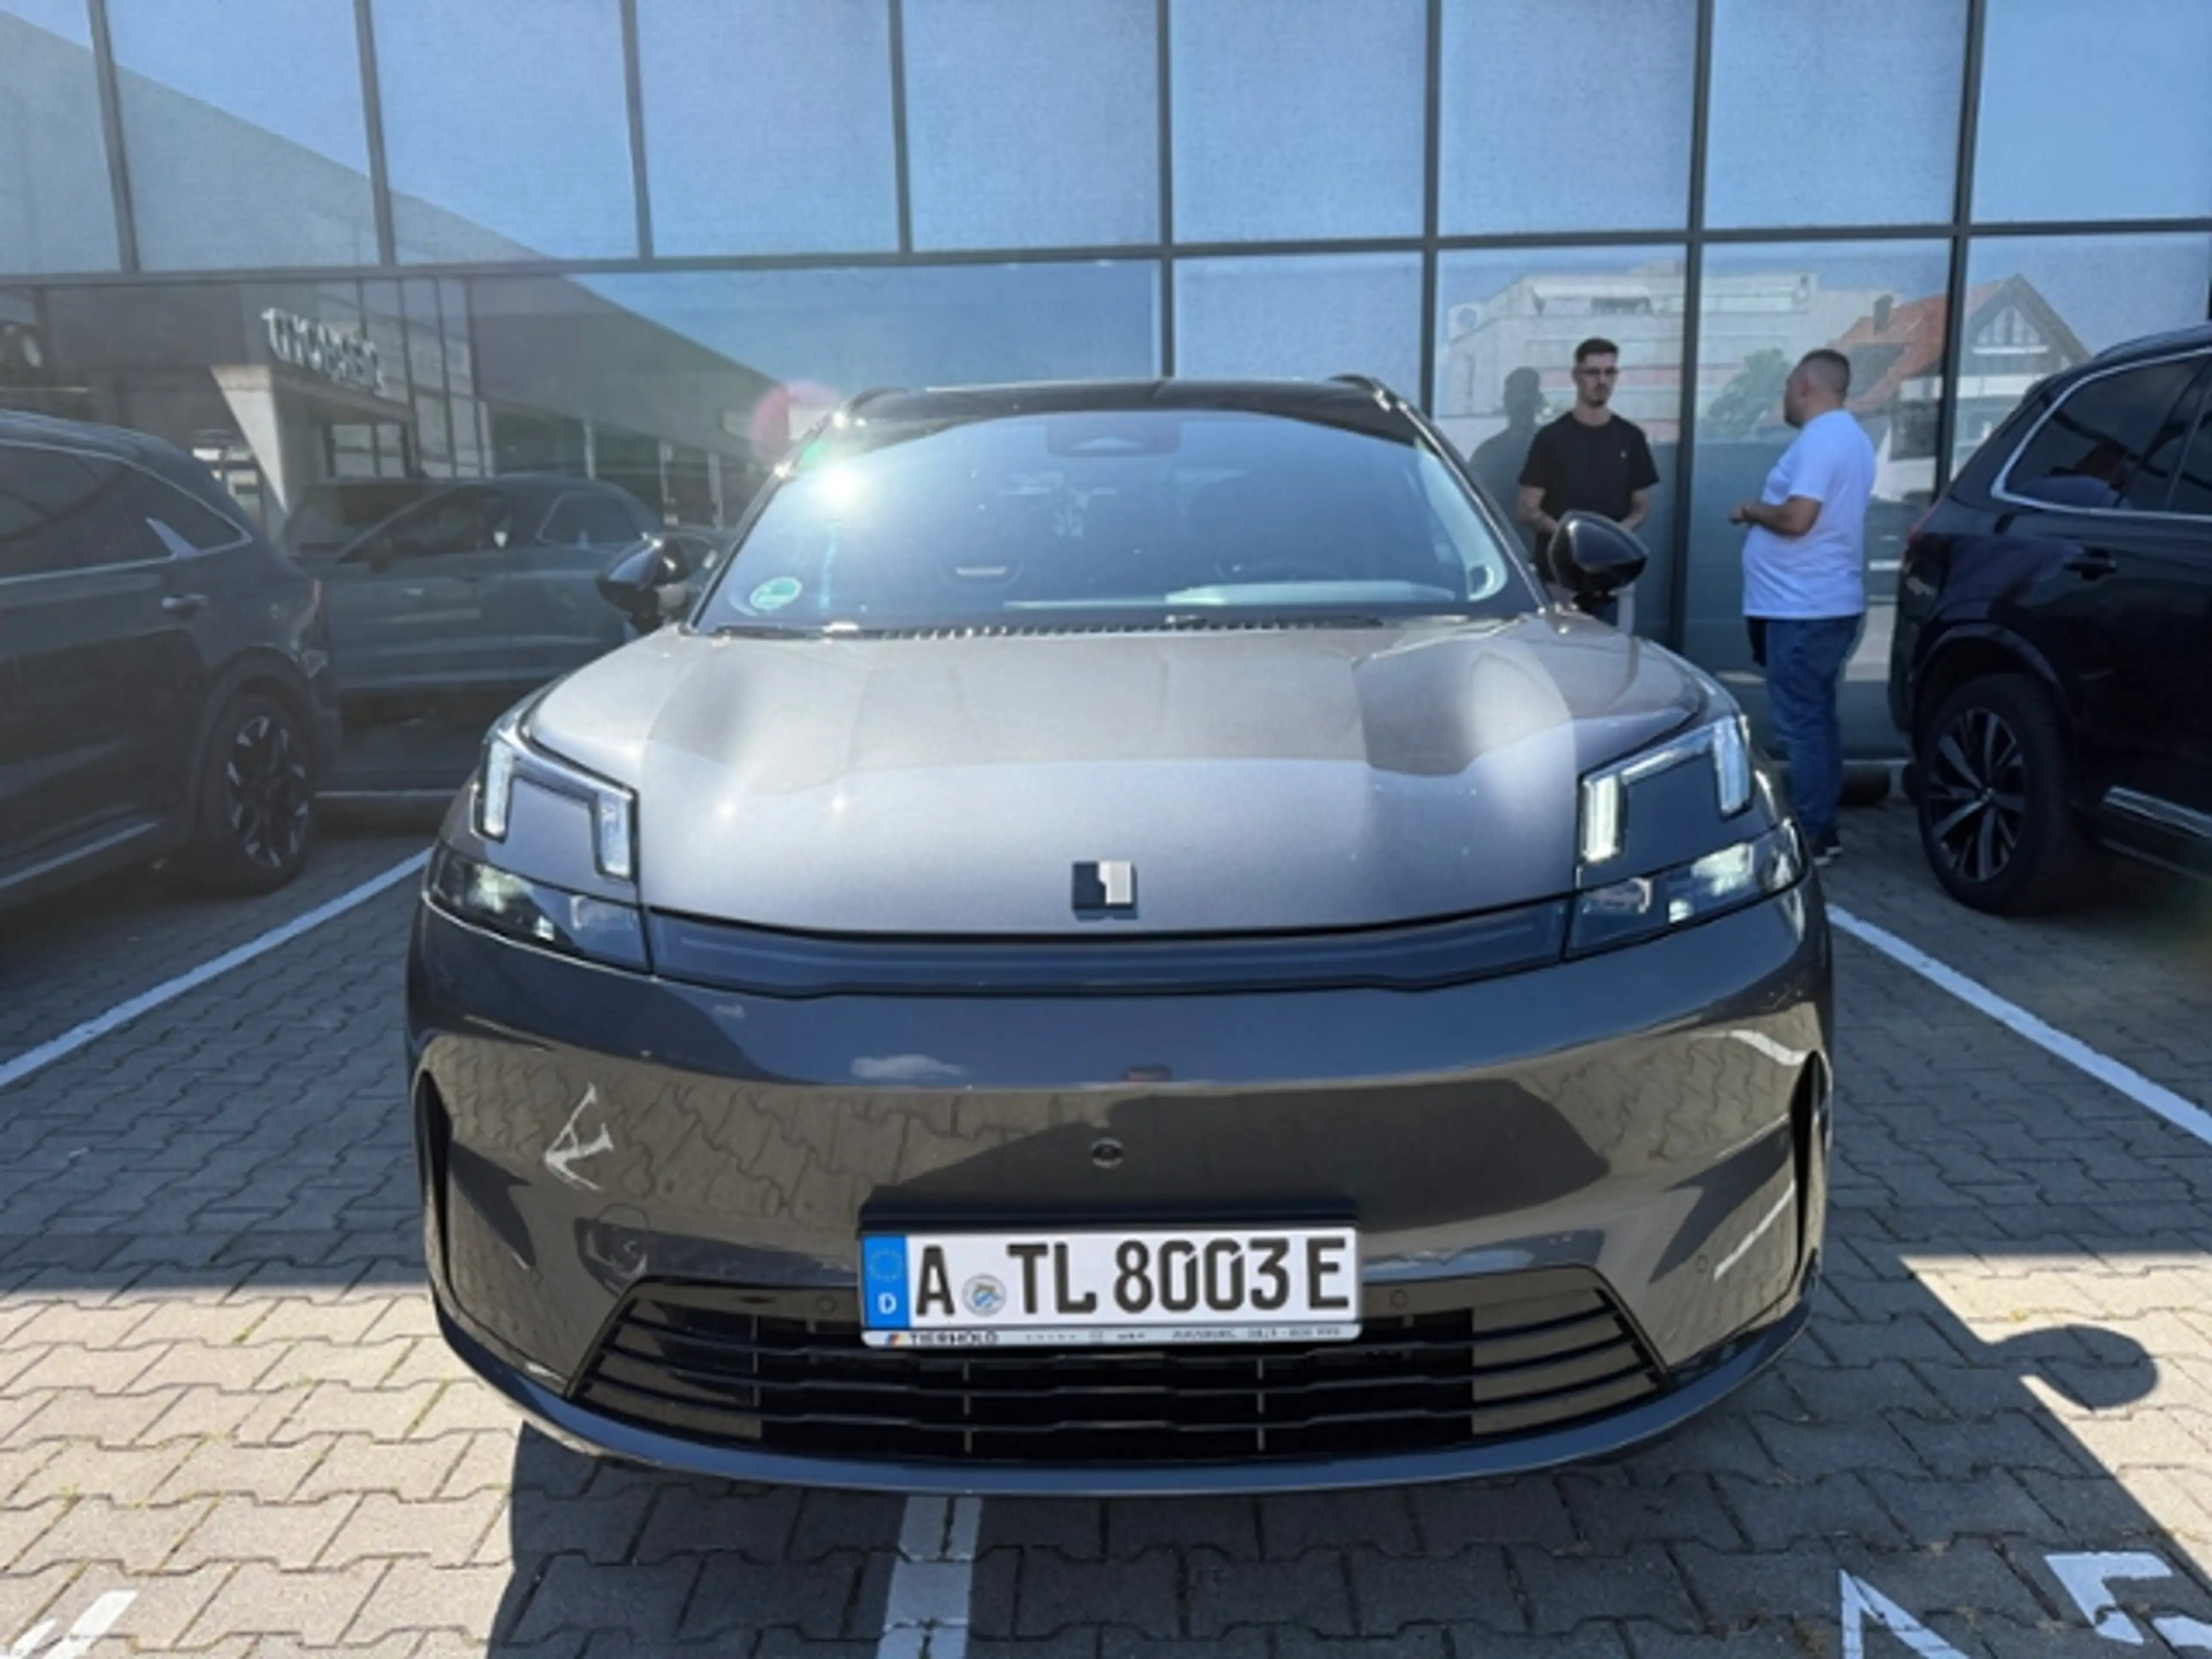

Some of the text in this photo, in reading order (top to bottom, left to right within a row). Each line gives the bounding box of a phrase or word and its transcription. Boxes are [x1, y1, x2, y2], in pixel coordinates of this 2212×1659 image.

[878, 1293, 896, 1314] D
[915, 1244, 956, 1317] A
[1006, 1242, 1097, 1315] TL
